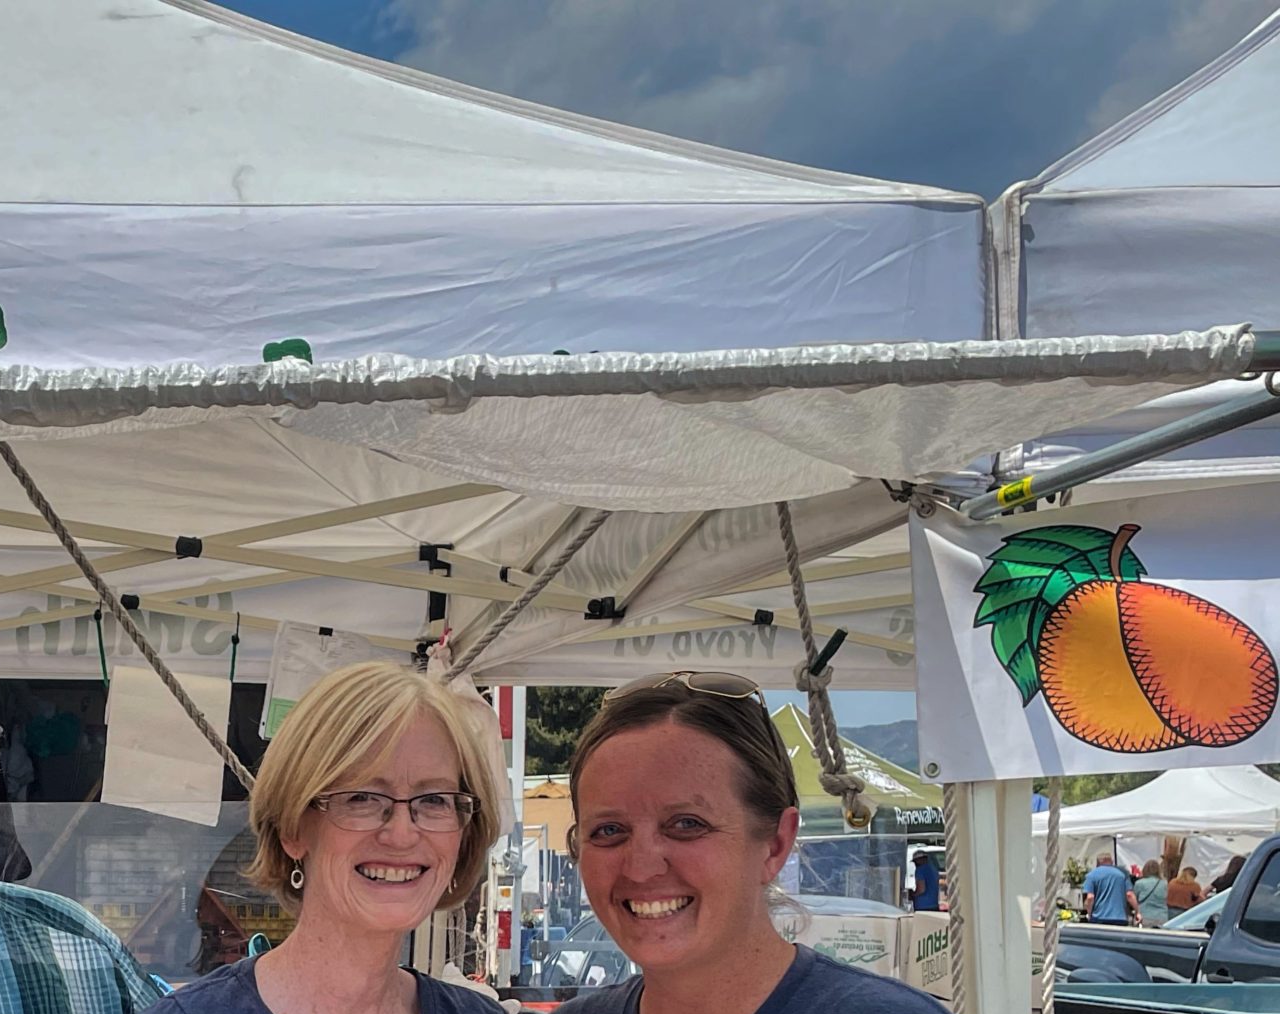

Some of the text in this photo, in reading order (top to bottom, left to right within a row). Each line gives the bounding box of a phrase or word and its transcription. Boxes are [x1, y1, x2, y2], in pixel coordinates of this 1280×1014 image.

[893, 806, 932, 825] Renewal
[916, 926, 949, 962] FRUIT
[922, 952, 948, 987] UTAH
